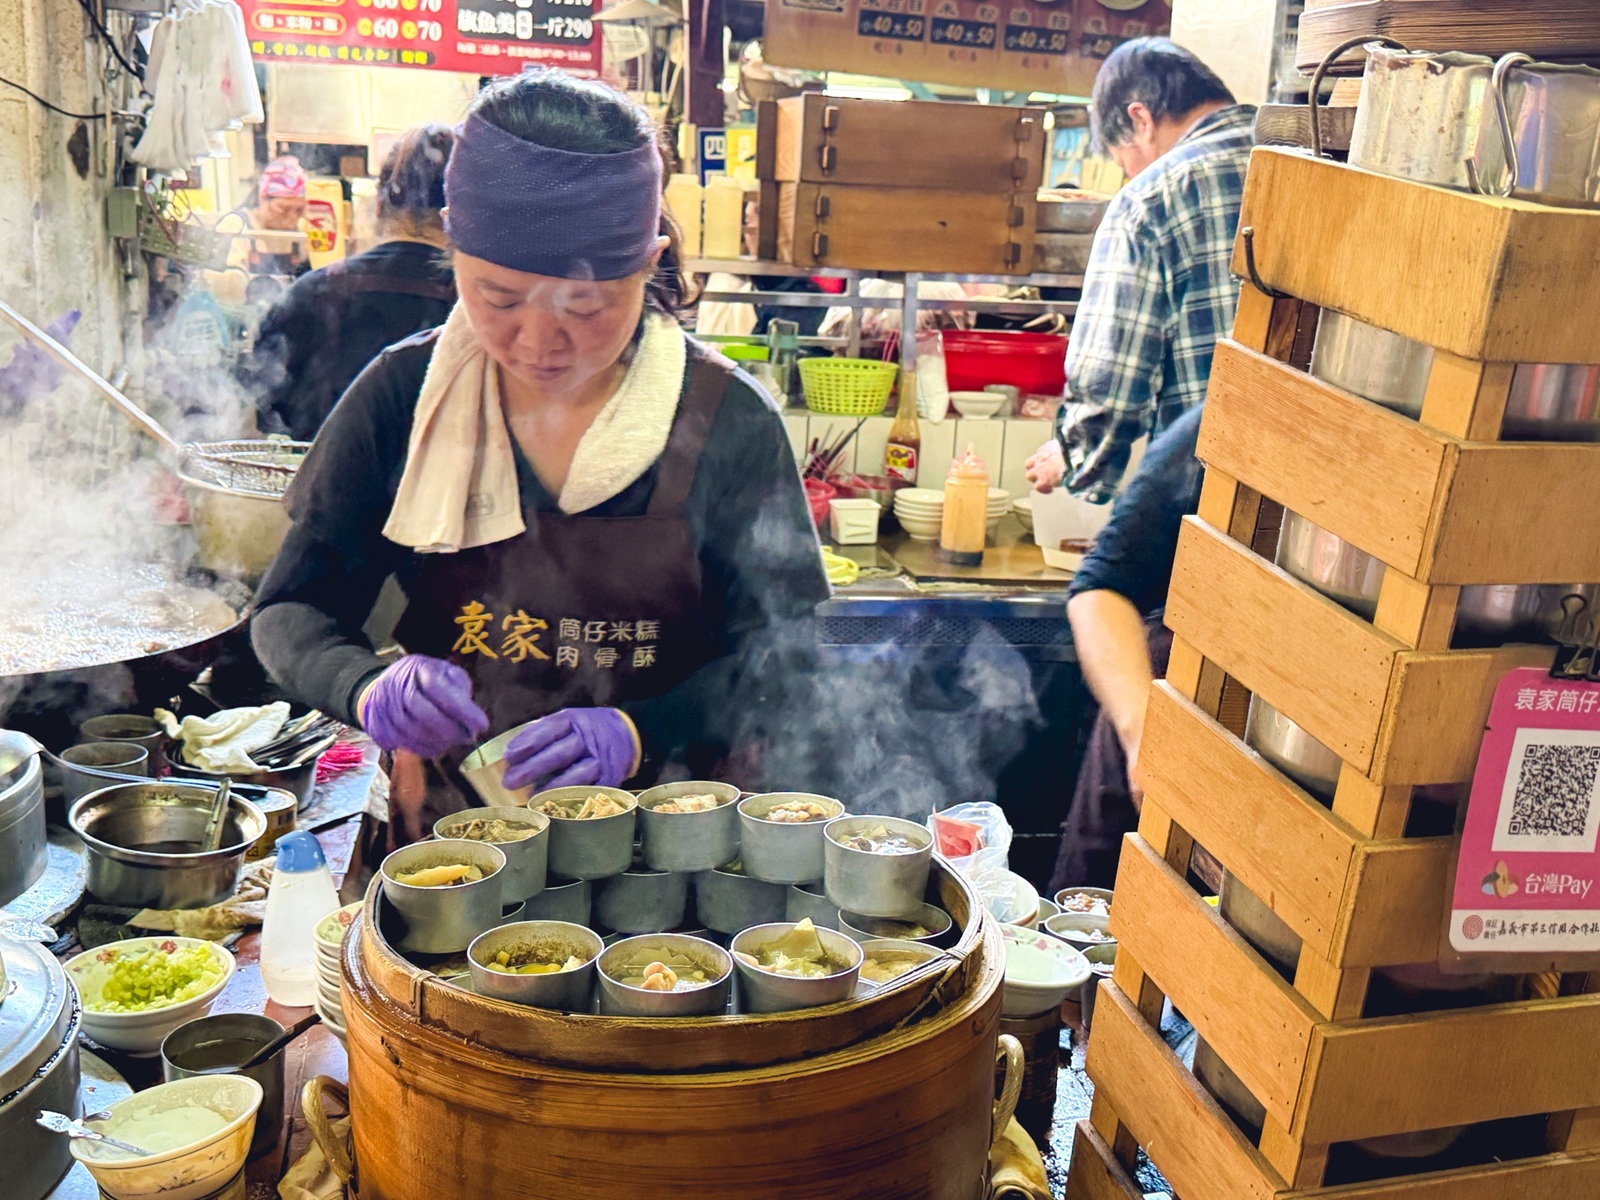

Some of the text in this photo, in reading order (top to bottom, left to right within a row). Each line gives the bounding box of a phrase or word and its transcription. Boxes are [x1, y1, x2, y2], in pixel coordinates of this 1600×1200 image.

[373, 17, 398, 39] 60
[417, 20, 442, 42] 70
[452, 600, 661, 663] 袁家 筒仔米糕
[1514, 688, 1600, 714] 袁家筒仔
[1525, 873, 1593, 900] 台灣Pay
